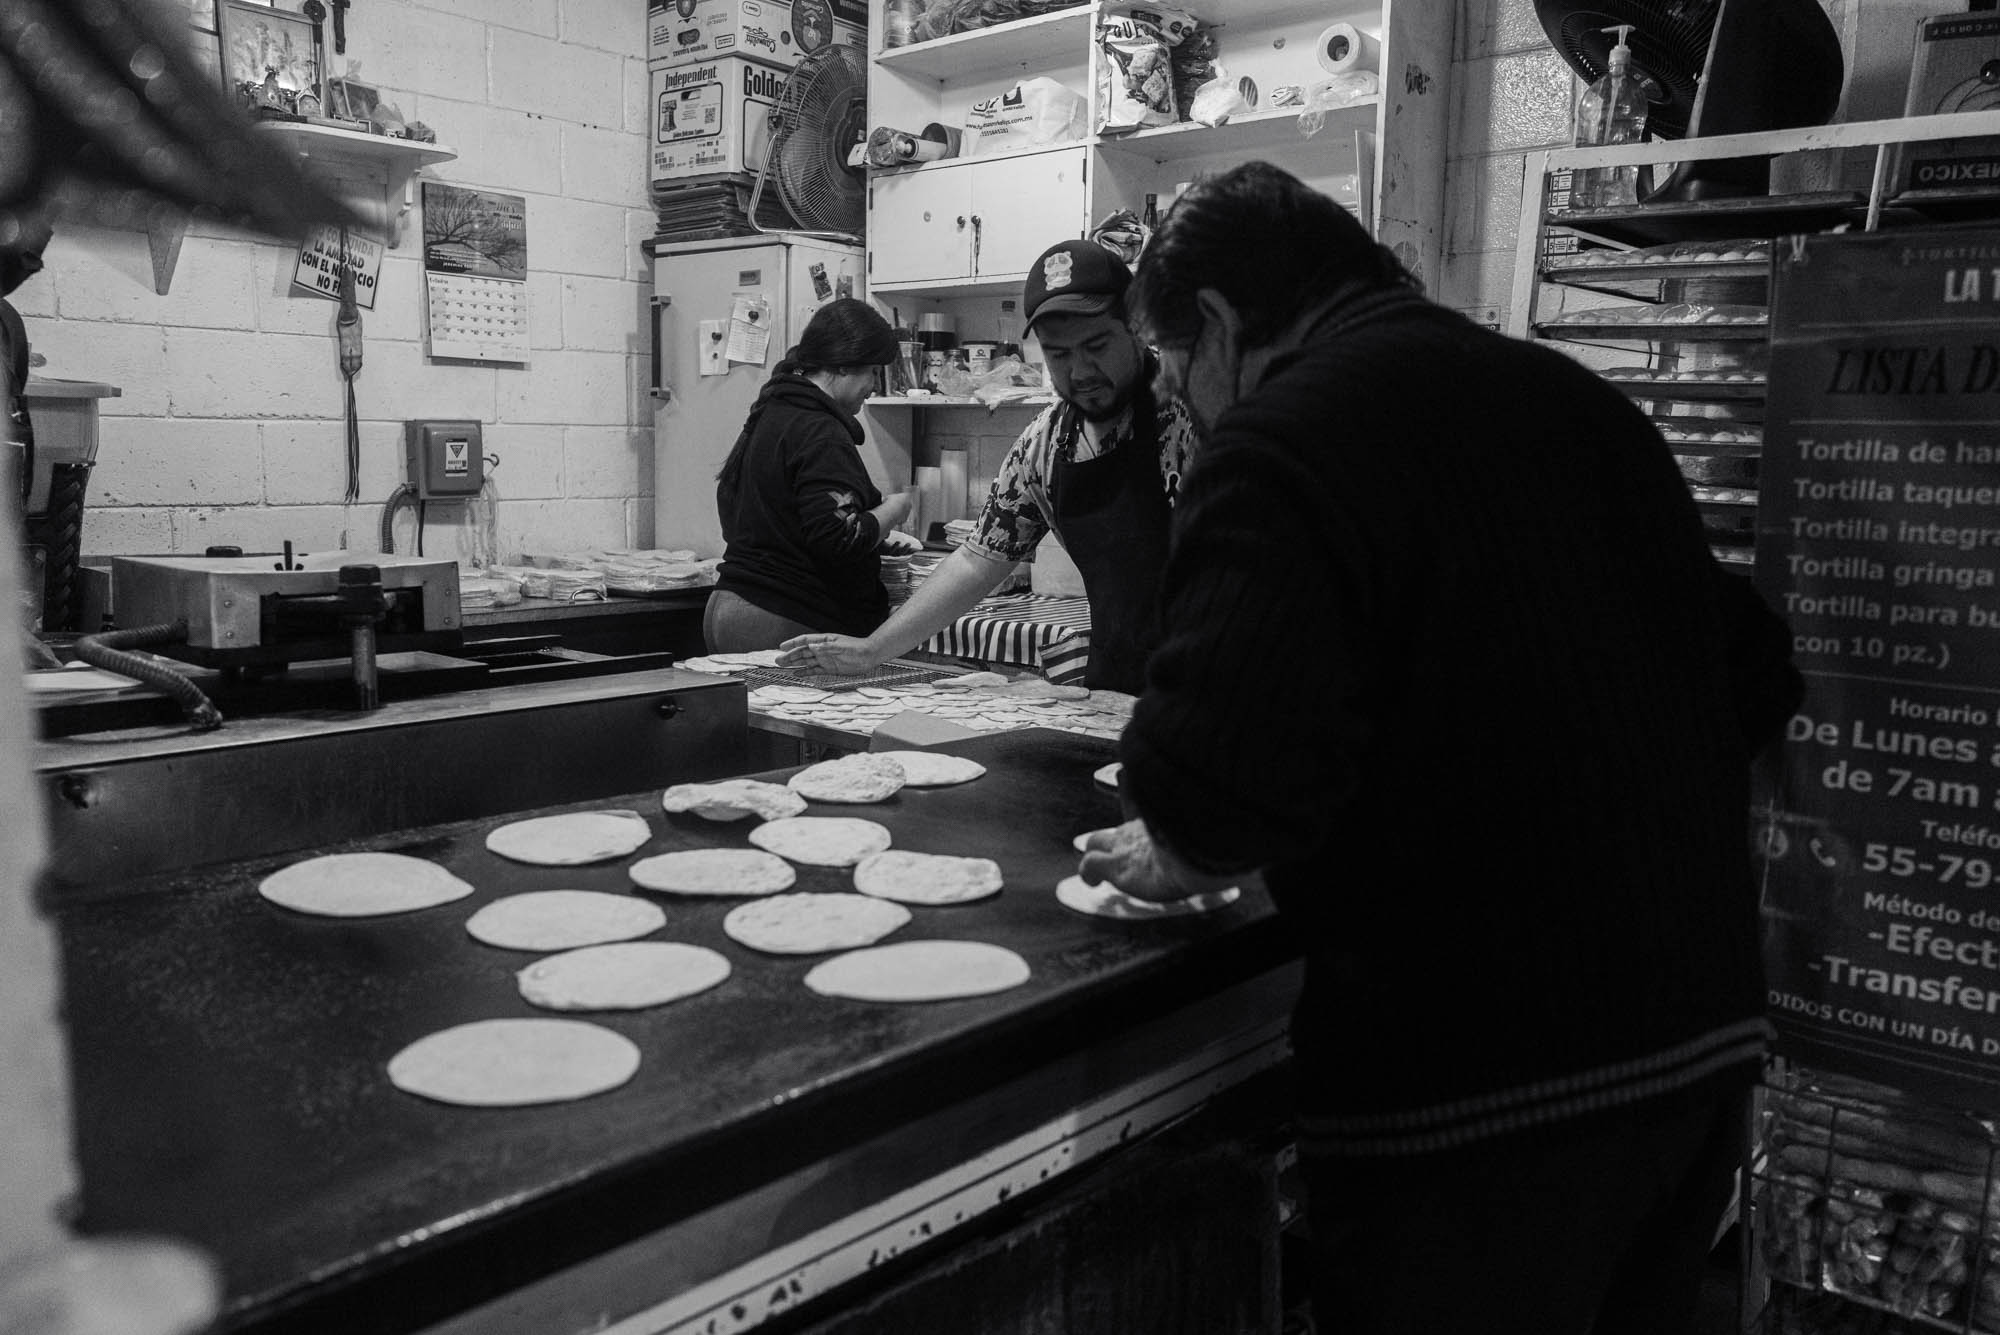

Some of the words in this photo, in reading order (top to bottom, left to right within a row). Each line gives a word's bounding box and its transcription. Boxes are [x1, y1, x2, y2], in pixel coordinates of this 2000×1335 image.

[665, 65, 718, 90] Independent
[744, 64, 785, 98] Golde
[301, 251, 319, 269] CON
[320, 258, 329, 273] EL
[331, 262, 374, 288] NCIO
[314, 240, 324, 255] LA
[325, 244, 365, 269] AMSTAD
[316, 273, 330, 290] NO
[1944, 269, 1980, 303] LA
[1826, 347, 1947, 395] LISTA
[1798, 439, 1899, 462] Tortilla
[1908, 441, 1947, 463] de
[1794, 477, 1895, 501] Tortilla
[1790, 516, 1889, 541] Tortilla
[1787, 554, 1885, 580] Tortilla
[1893, 561, 1995, 590] gringa
[1783, 592, 1881, 620] Tortilla
[1890, 603, 1959, 626] para
[1793, 635, 1841, 655] con
[1851, 636, 1884, 658] 10
[1893, 643, 1950, 670] pz.)
[1890, 698, 1988, 726] Horario
[1787, 714, 1839, 746] De
[1853, 720, 1978, 763] Lunes
[1822, 760, 1873, 793] de
[1887, 767, 1980, 808] 7am
[1920, 819, 2000, 849] Teléfo
[1864, 891, 1962, 925] Método
[1968, 909, 2000, 932] de
[1808, 954, 2000, 1014] -Transfer
[1837, 1007, 1886, 1032] CON
[1891, 1019, 1926, 1041] UN
[1931, 1026, 1975, 1052] DÍA
